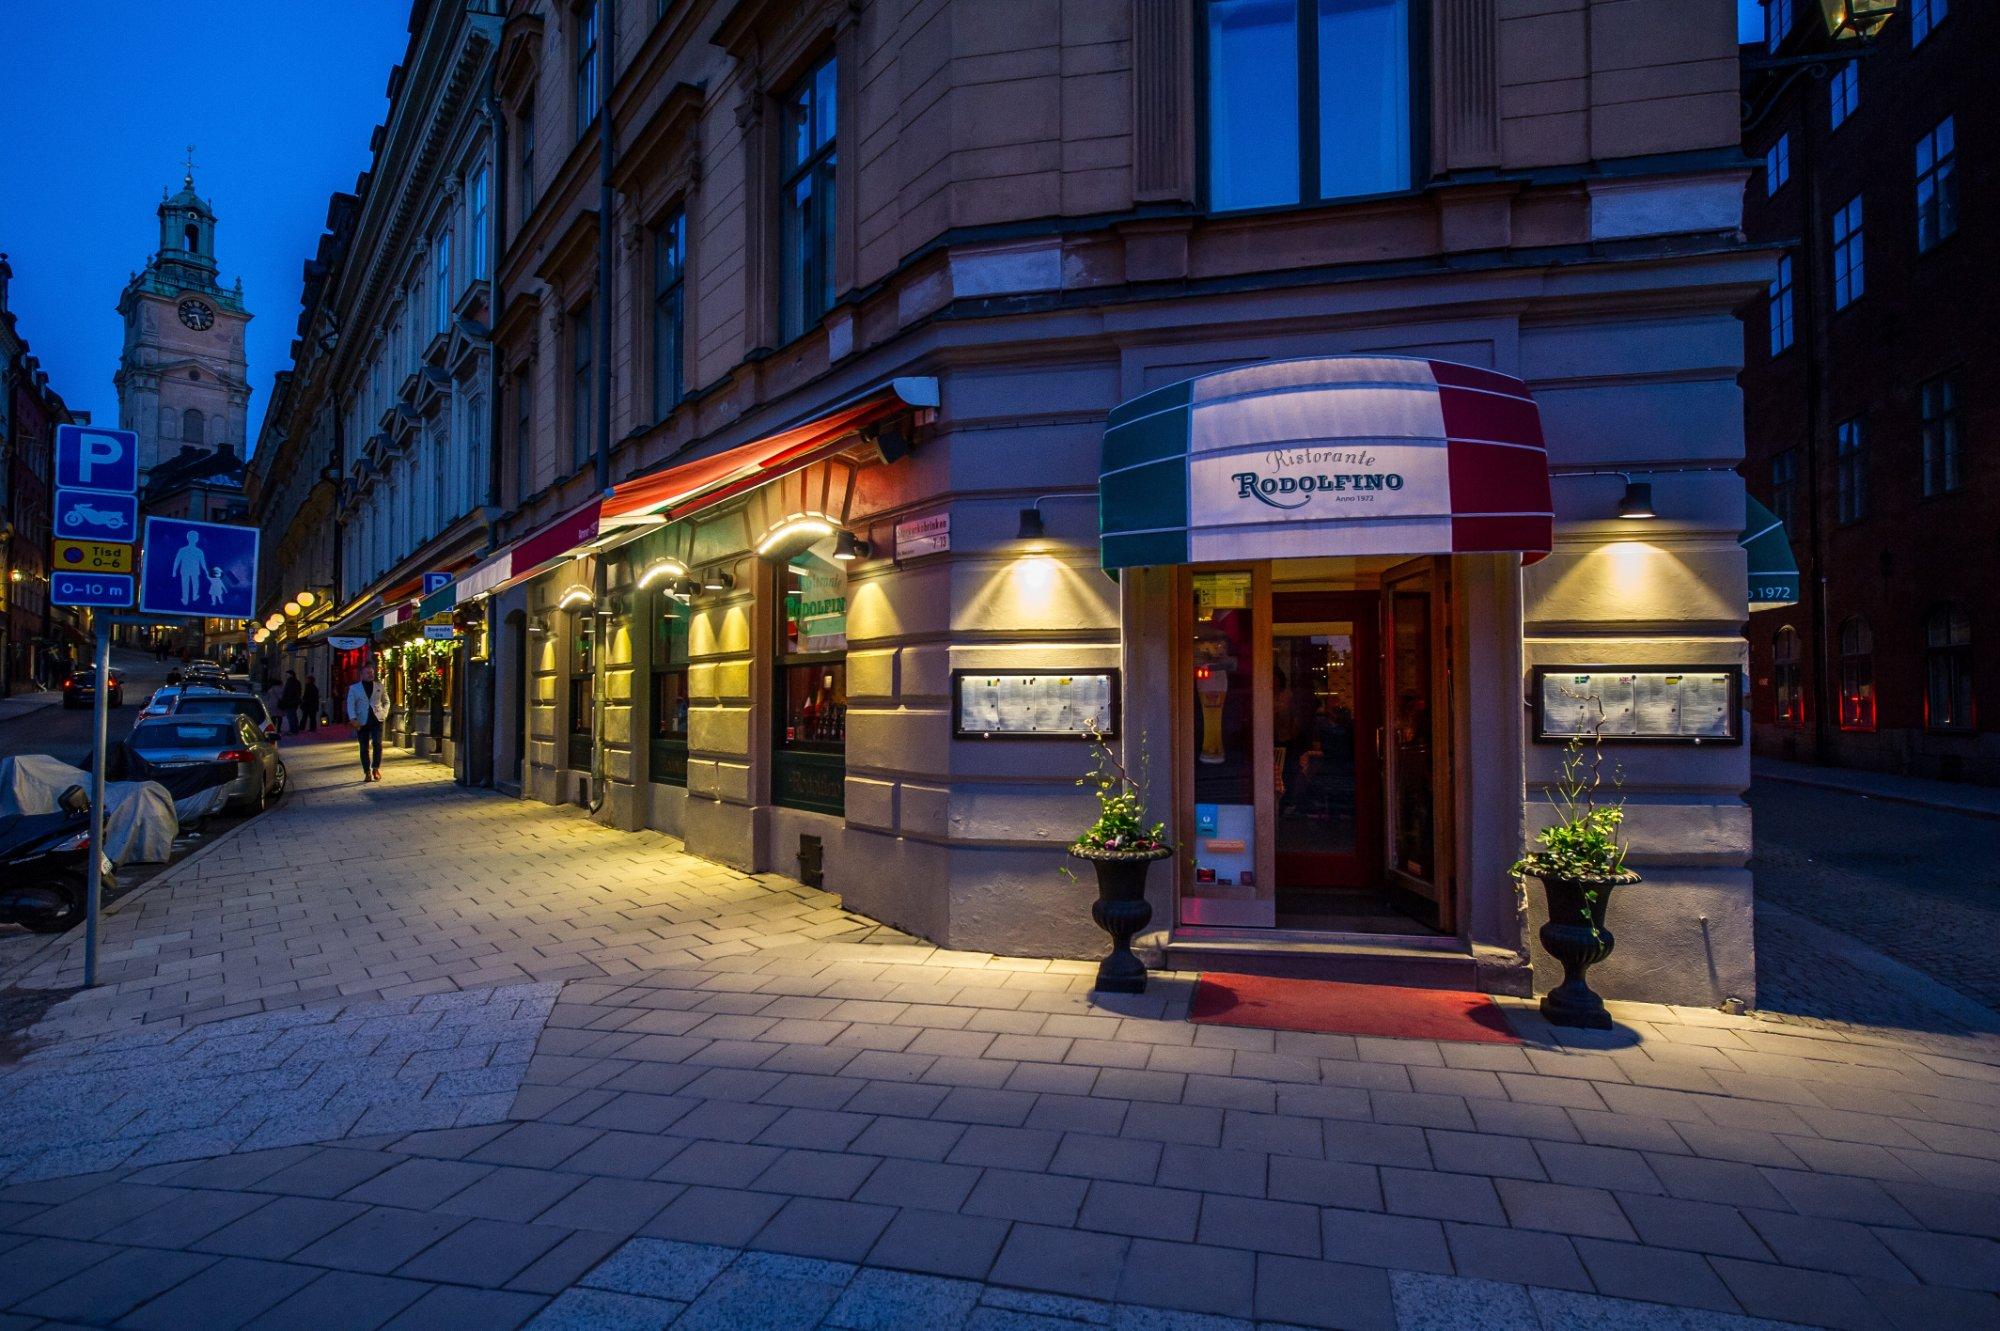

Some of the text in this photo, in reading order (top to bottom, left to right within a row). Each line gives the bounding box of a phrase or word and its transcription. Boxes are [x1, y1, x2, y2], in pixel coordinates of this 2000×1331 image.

[79, 433, 123, 483] P
[1266, 449, 1376, 474] Ristorante
[1231, 472, 1404, 510] RODOLFINO
[93, 547, 122, 557] Tisd
[61, 583, 122, 595] 0-10 m
[1758, 587, 1790, 598] 1972
